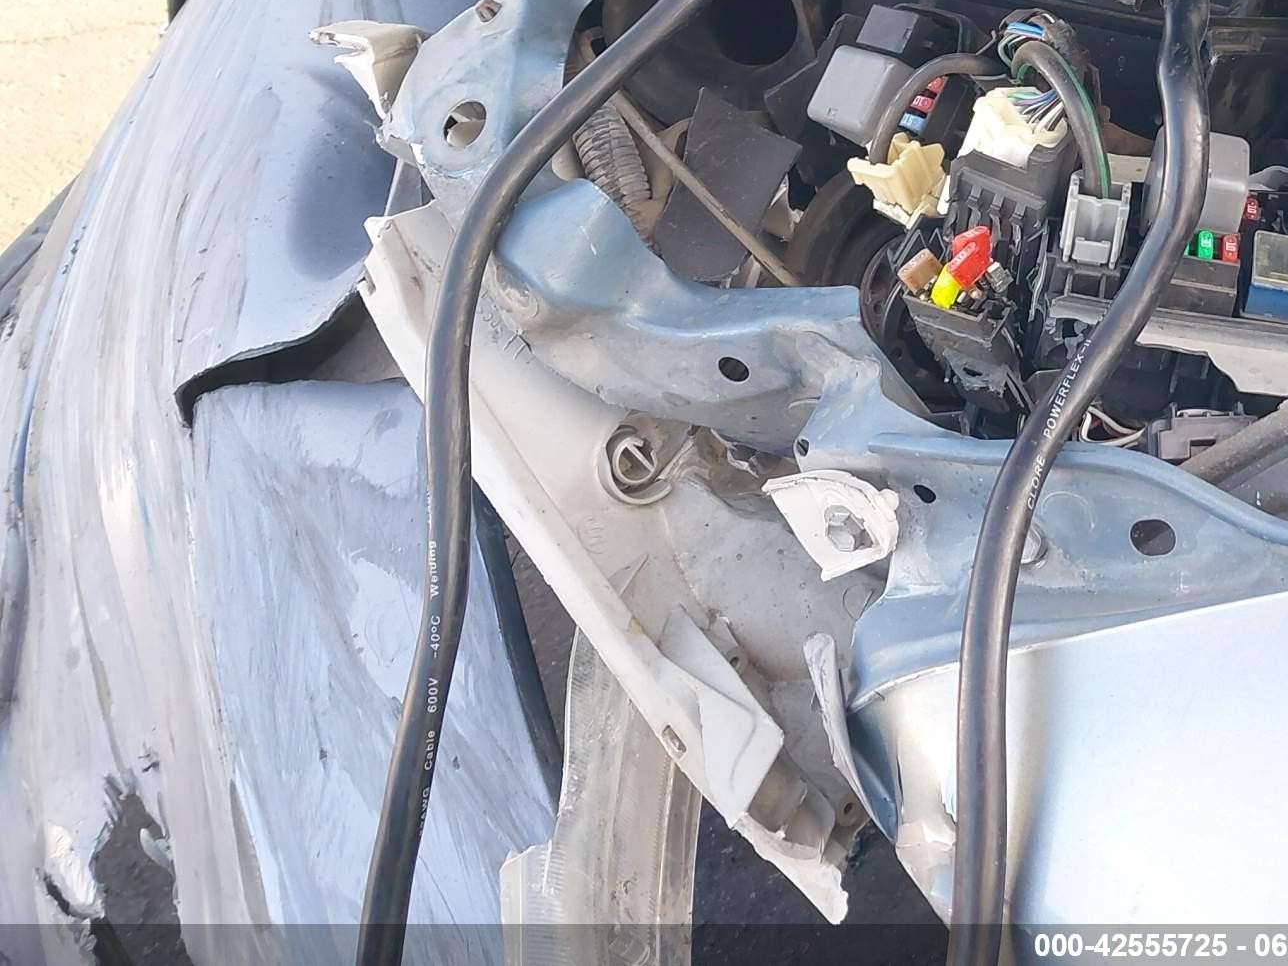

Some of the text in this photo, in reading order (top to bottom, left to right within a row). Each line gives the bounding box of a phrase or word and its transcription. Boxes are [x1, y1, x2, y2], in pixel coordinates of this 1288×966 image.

[1027, 454, 1046, 510] CLORE
[428, 540, 440, 601] Welding
[427, 677, 440, 713] 600V
[424, 730, 436, 771] Cable
